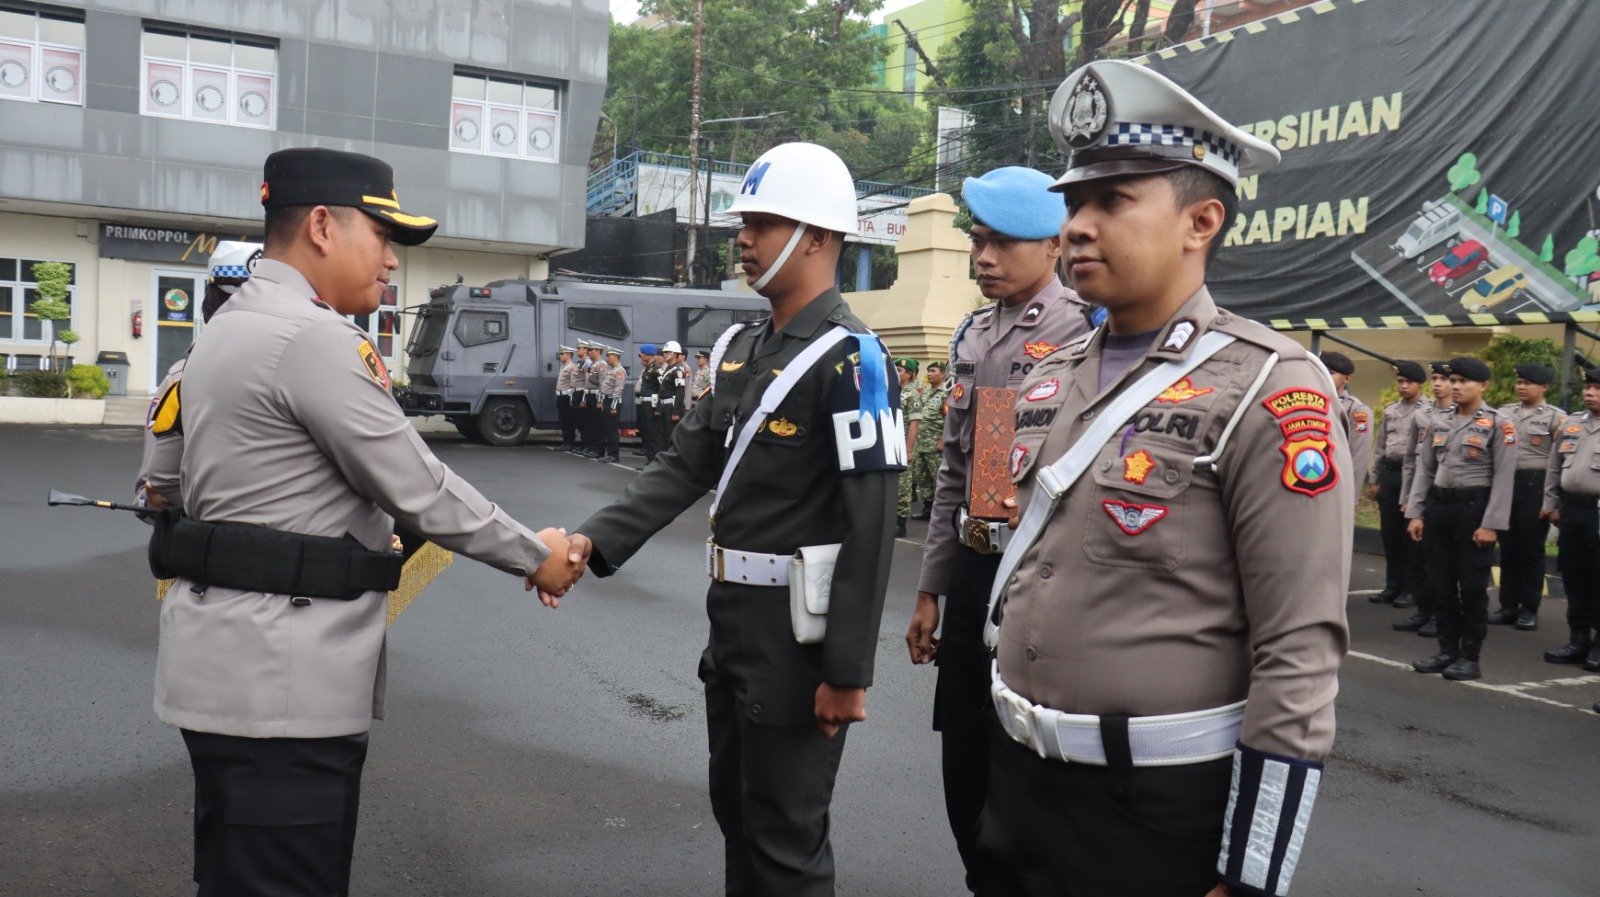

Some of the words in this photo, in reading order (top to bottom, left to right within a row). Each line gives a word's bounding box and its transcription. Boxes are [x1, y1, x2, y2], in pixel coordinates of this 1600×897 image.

[105, 225, 191, 244] PRIMKOPPOL
[674, 378, 686, 387] PM
[1270, 392, 1326, 408] POLRESTA
[832, 407, 908, 471] PM
